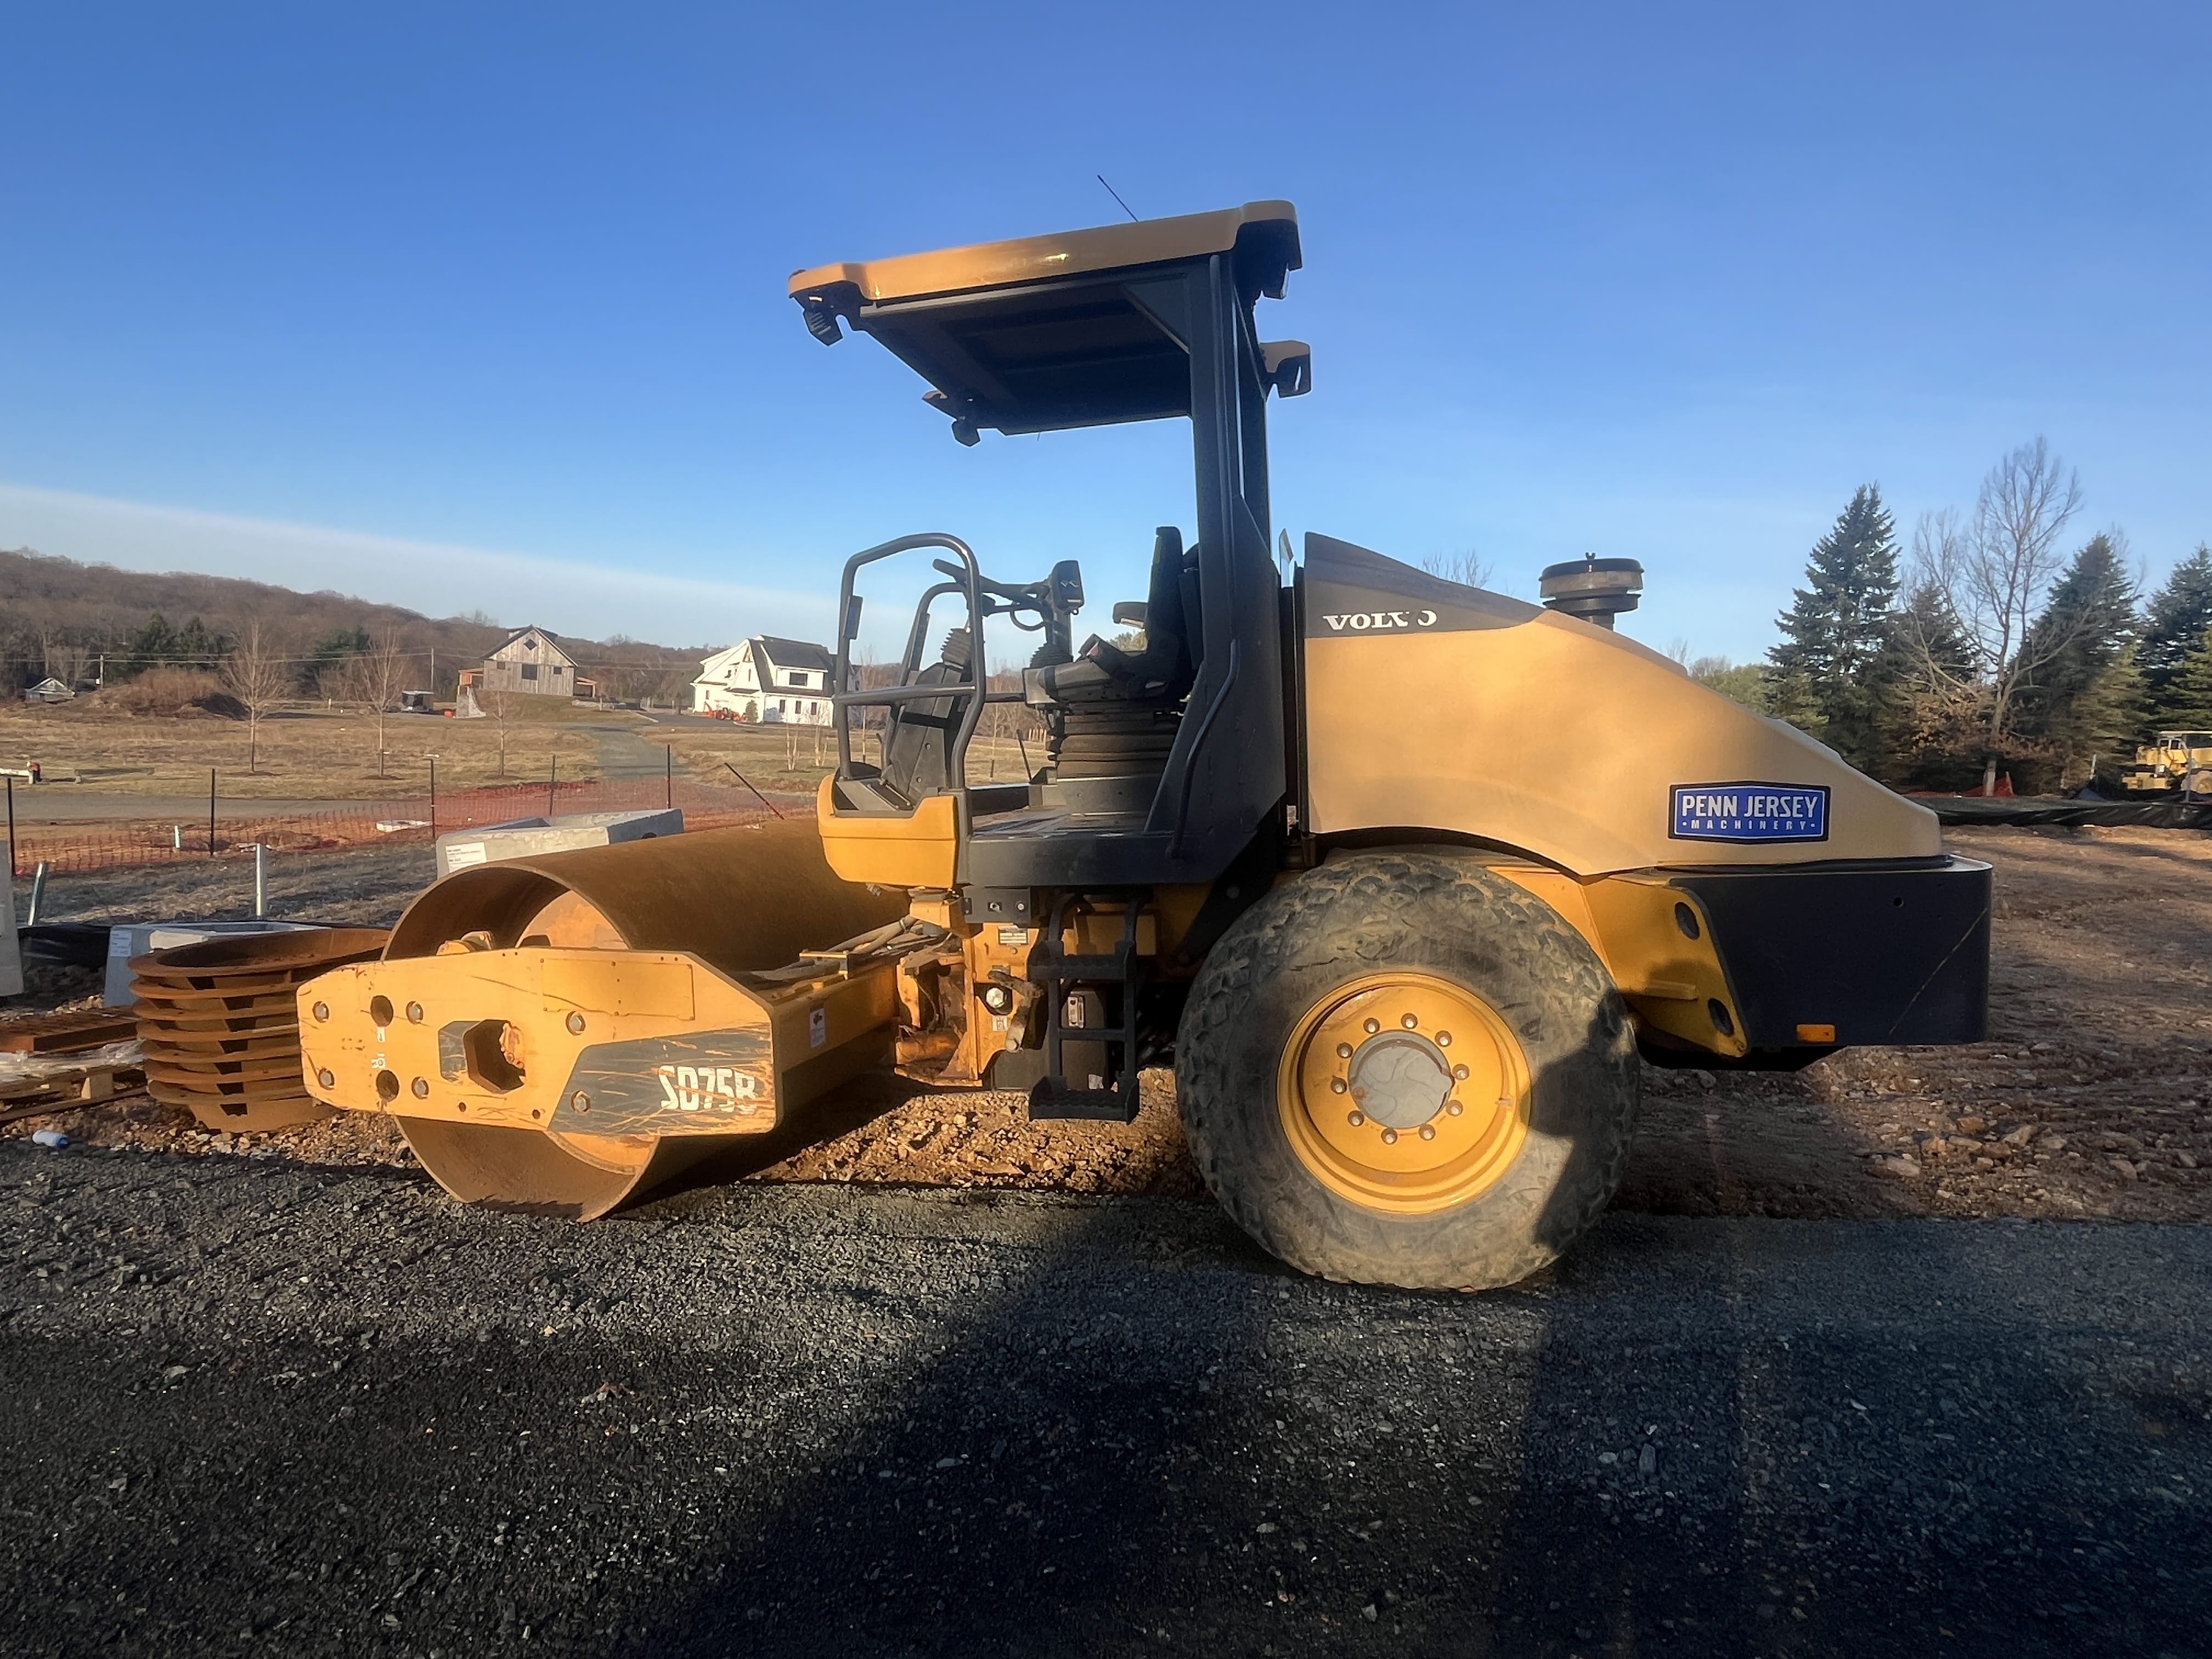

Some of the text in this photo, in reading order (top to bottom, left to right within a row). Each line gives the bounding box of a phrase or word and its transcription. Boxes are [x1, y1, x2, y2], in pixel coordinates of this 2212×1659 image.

[1682, 795, 1818, 818] PENN JERSEY
[1690, 820, 1807, 831] MACHINERY
